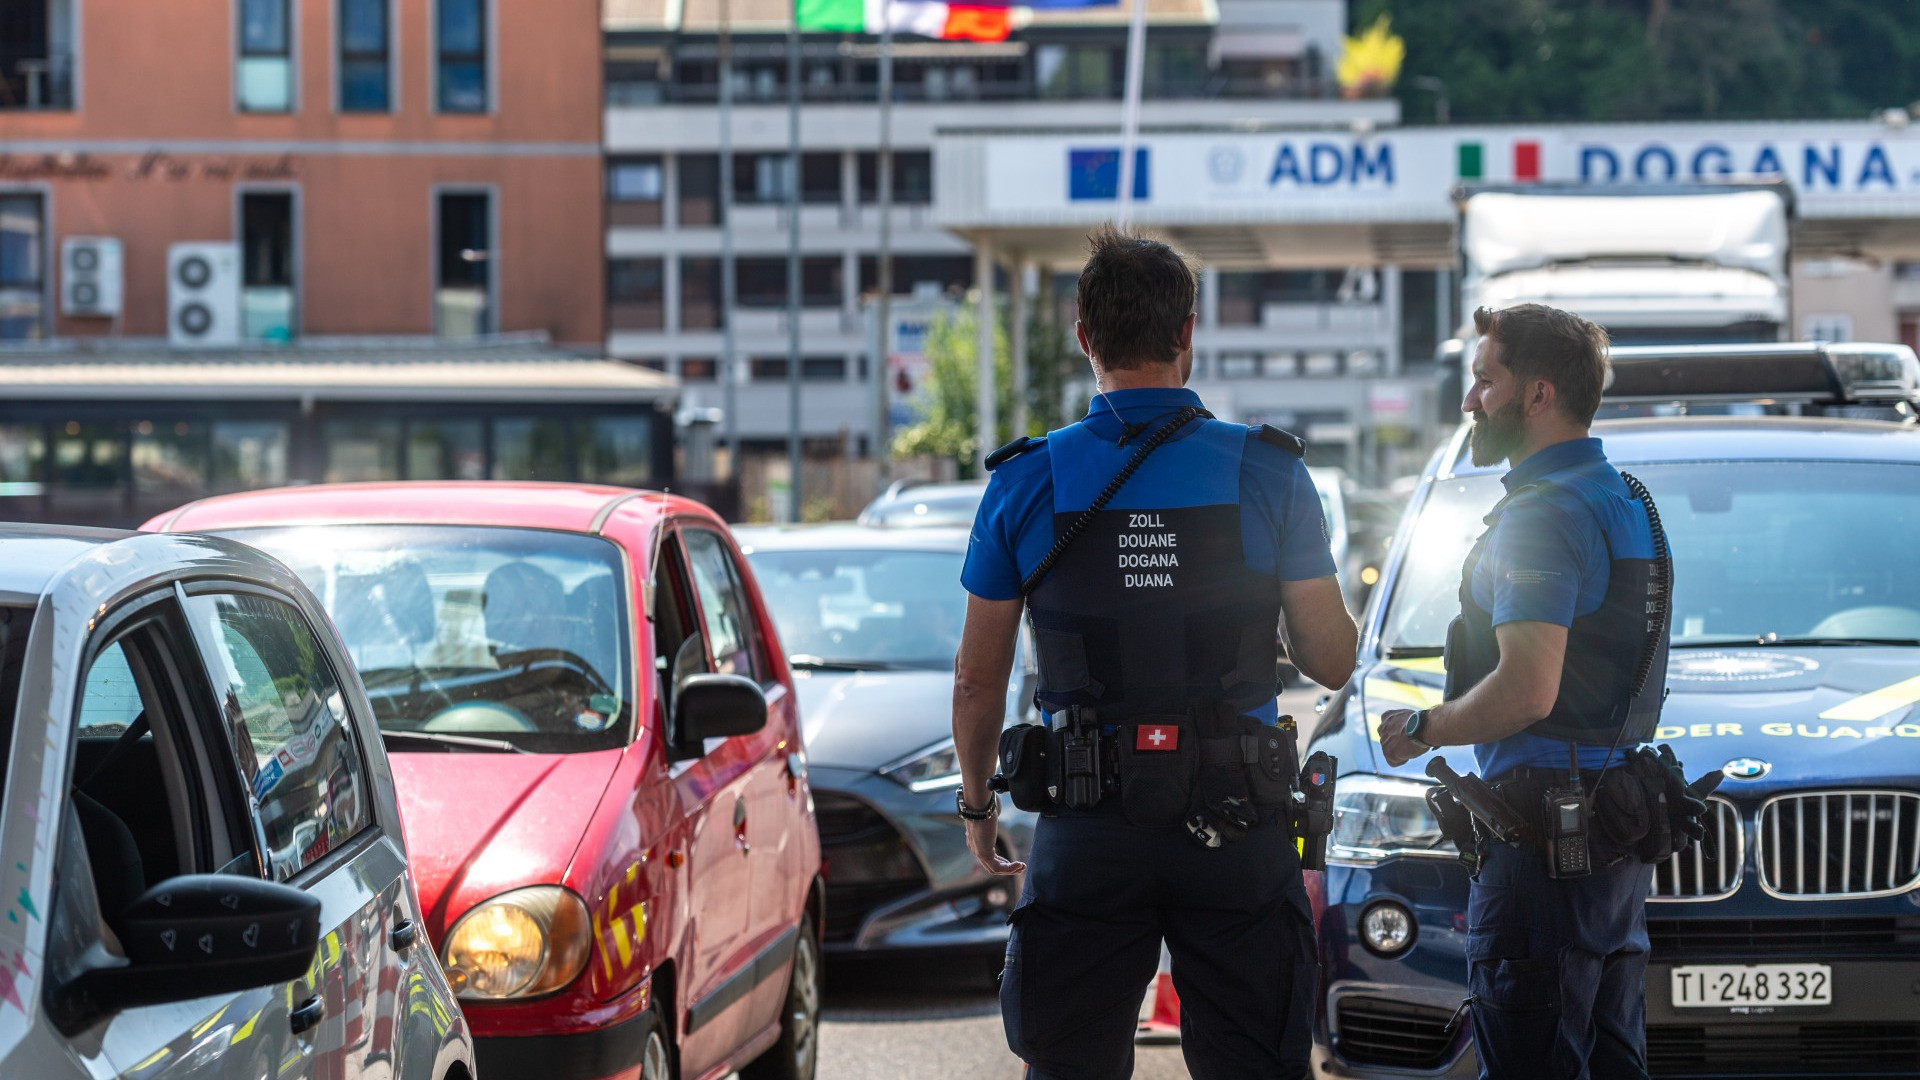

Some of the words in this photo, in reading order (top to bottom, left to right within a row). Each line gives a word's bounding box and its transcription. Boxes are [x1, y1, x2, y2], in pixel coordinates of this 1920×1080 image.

[1268, 142, 1395, 185] ADM
[1578, 142, 1896, 187] DOGANA
[1128, 513, 1165, 528] ZOLL
[1118, 533, 1177, 548] DOUANE
[1118, 553, 1179, 568] DOGANA
[1124, 573, 1174, 588] DUANA
[1760, 722, 1920, 739] GUARD
